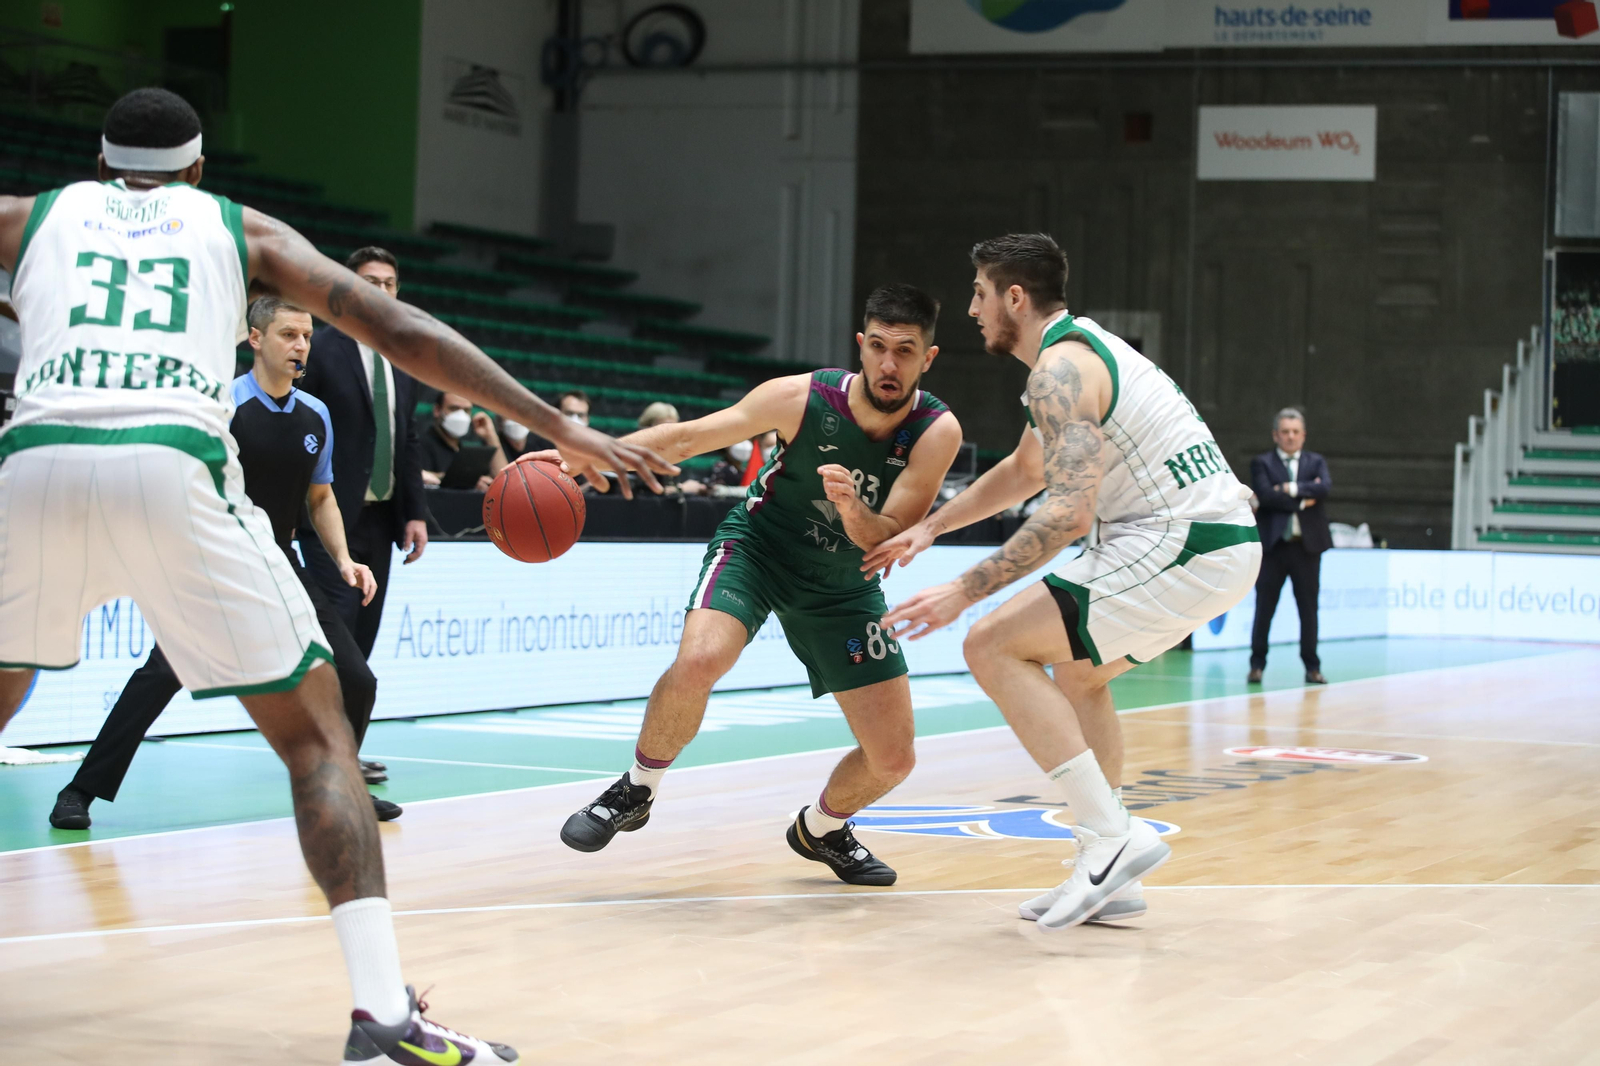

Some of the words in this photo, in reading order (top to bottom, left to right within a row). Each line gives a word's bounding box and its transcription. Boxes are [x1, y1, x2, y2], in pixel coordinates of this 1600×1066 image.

[69, 251, 190, 333] 33
[394, 603, 492, 659] Acteur
[500, 597, 684, 653] incontournable
[1453, 582, 1488, 610] du
[1498, 582, 1600, 622] dévelo
